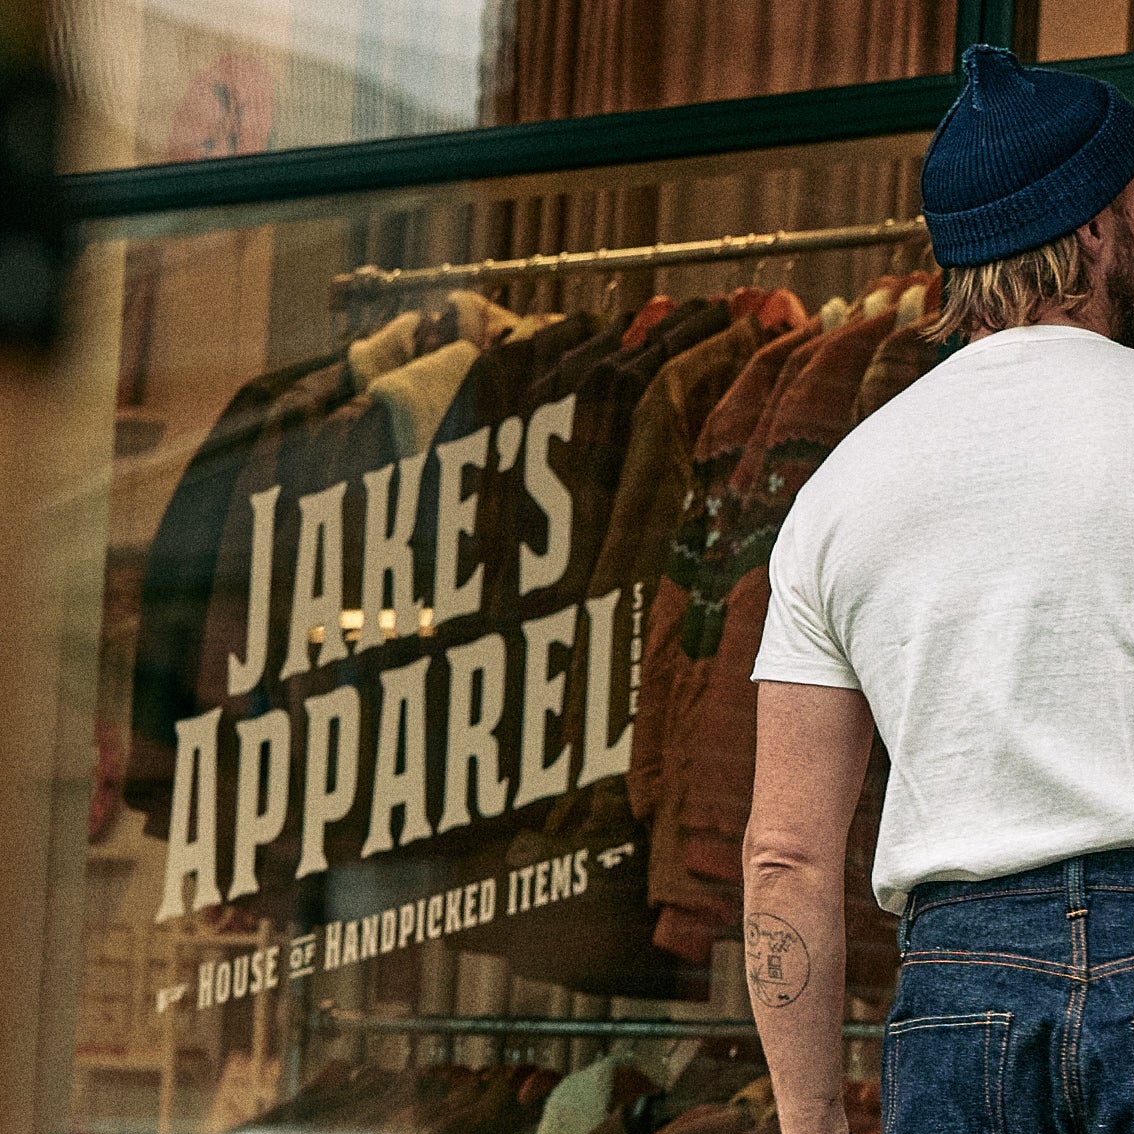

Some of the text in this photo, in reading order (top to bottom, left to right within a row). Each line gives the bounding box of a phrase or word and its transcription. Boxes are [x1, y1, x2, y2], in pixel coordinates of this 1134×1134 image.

[228, 393, 576, 697] JAKE'S
[156, 588, 635, 924] APPAREL
[197, 848, 590, 1011] HOUSE OF HANDPICKED ITEMS
